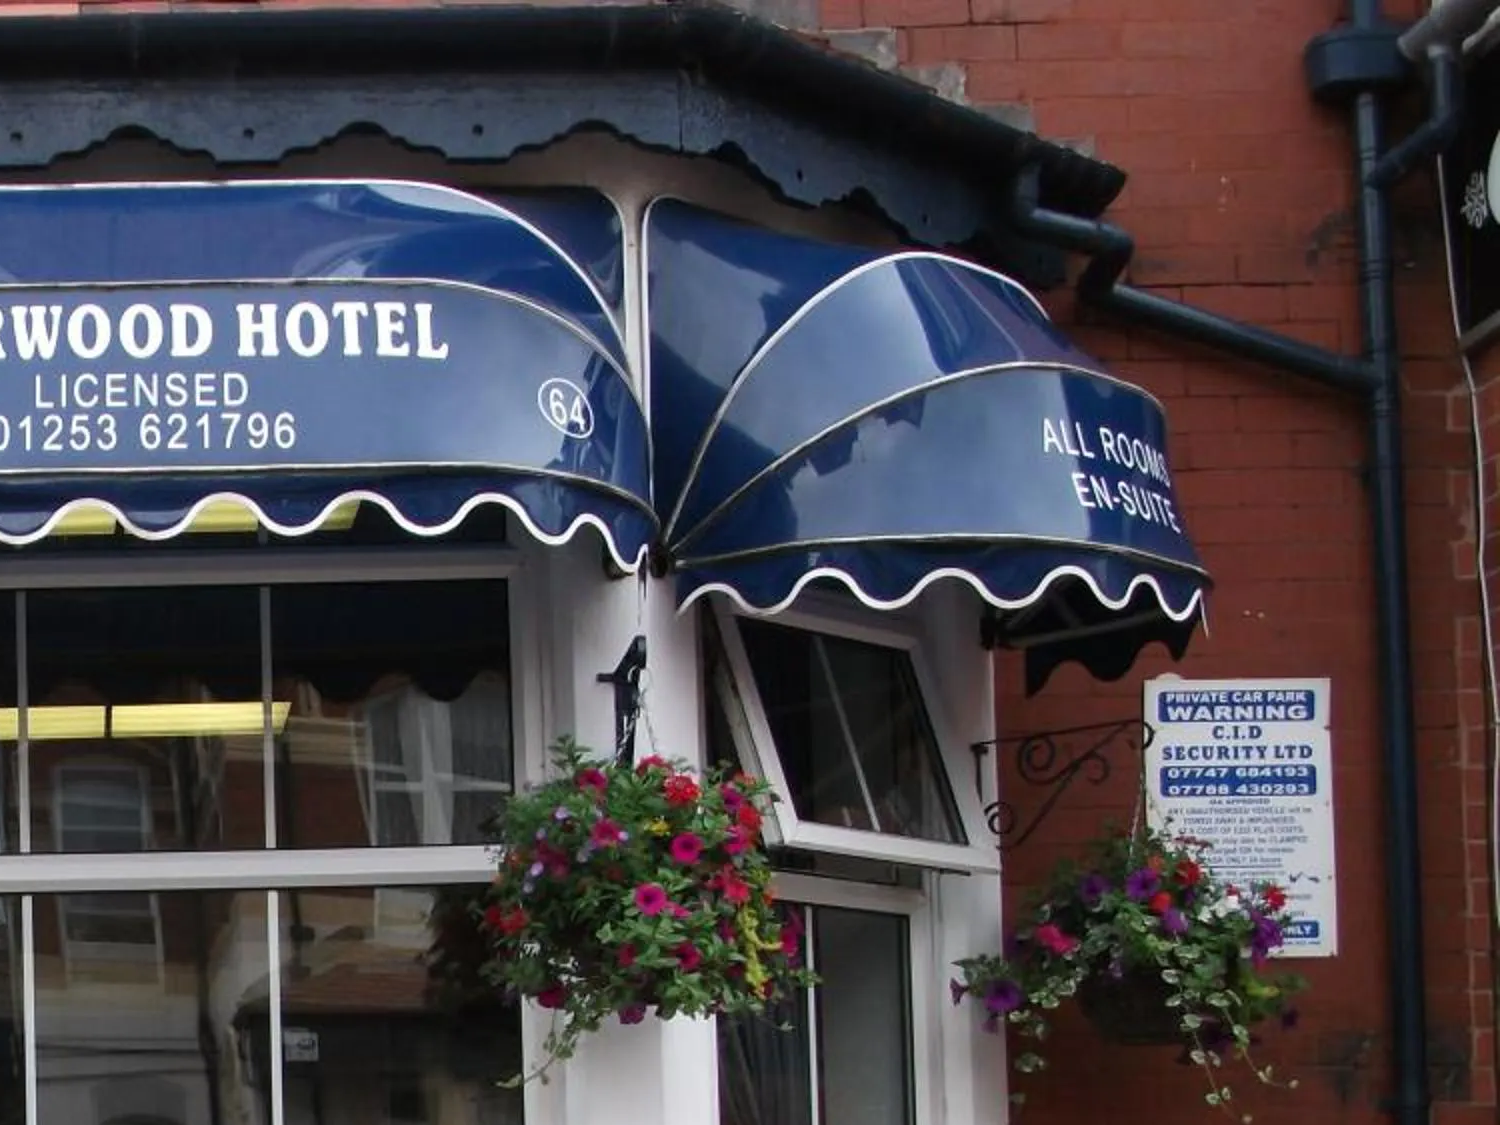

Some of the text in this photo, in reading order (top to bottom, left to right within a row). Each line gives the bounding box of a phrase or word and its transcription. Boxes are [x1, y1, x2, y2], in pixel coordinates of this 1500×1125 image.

[236, 301, 449, 360] HOTEL
[35, 373, 249, 408] LICENSED
[549, 388, 586, 432] 64
[139, 411, 296, 450] 621796
[1042, 417, 1172, 489] ALL ROOMS
[1071, 471, 1182, 535] EN-SUITE
[1166, 690, 1307, 703] PRIVATE CAR PARK
[1166, 704, 1308, 721] WARNING
[1212, 725, 1262, 740] C.I.D
[1162, 744, 1313, 761] SECURITY LTD
[1167, 767, 1229, 779] 07747
[1168, 784, 1229, 795] 07788
[1282, 924, 1313, 936] NLY
